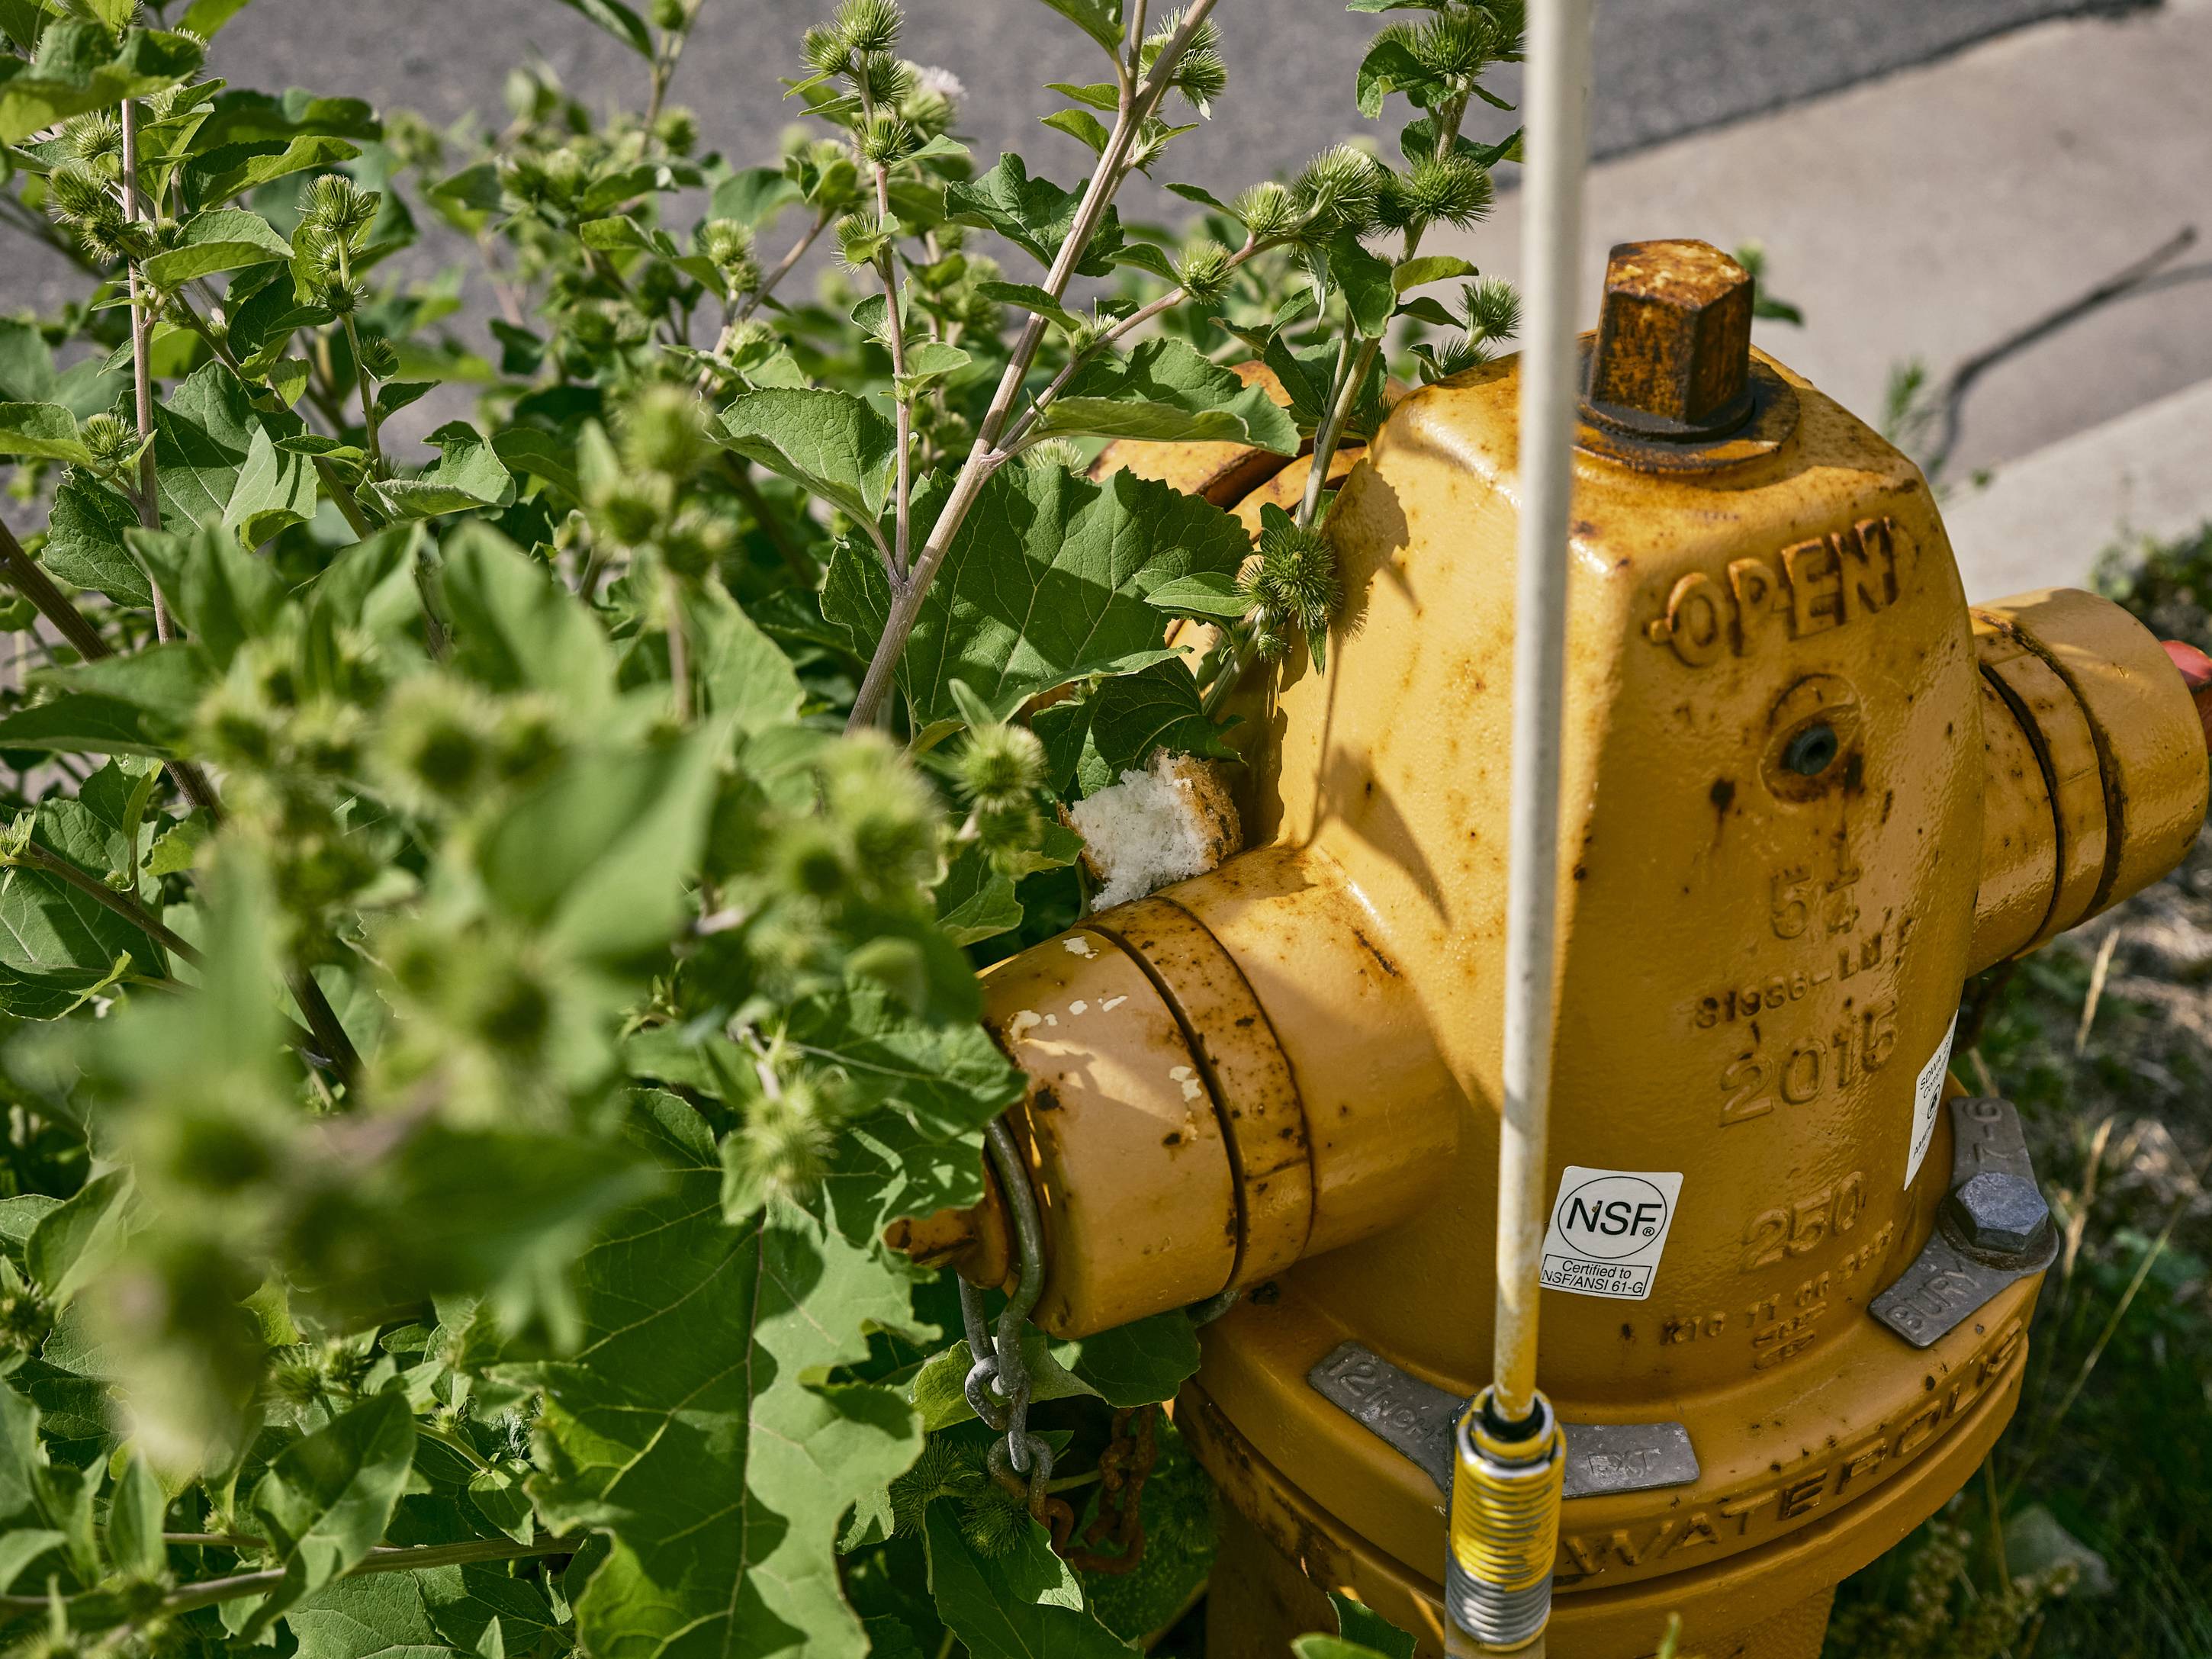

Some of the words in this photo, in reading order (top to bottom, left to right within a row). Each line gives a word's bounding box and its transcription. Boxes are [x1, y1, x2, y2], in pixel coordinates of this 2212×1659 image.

[1667, 516, 1901, 668] OPEN
[1740, 1171, 1866, 1272] 250
[1542, 1269, 1609, 1291] NSF/ANSI
[1611, 1280, 1644, 1294] 61-G
[1562, 1260, 1618, 1278] Certified
[1619, 1268, 1632, 1279] to
[1884, 1258, 1981, 1335] BURY
[1327, 1351, 1378, 1397] 12
[1364, 1386, 1439, 1444] INCH
[1564, 1317, 2023, 1575] WATEROUS
[1587, 1447, 1661, 1477] EXT
